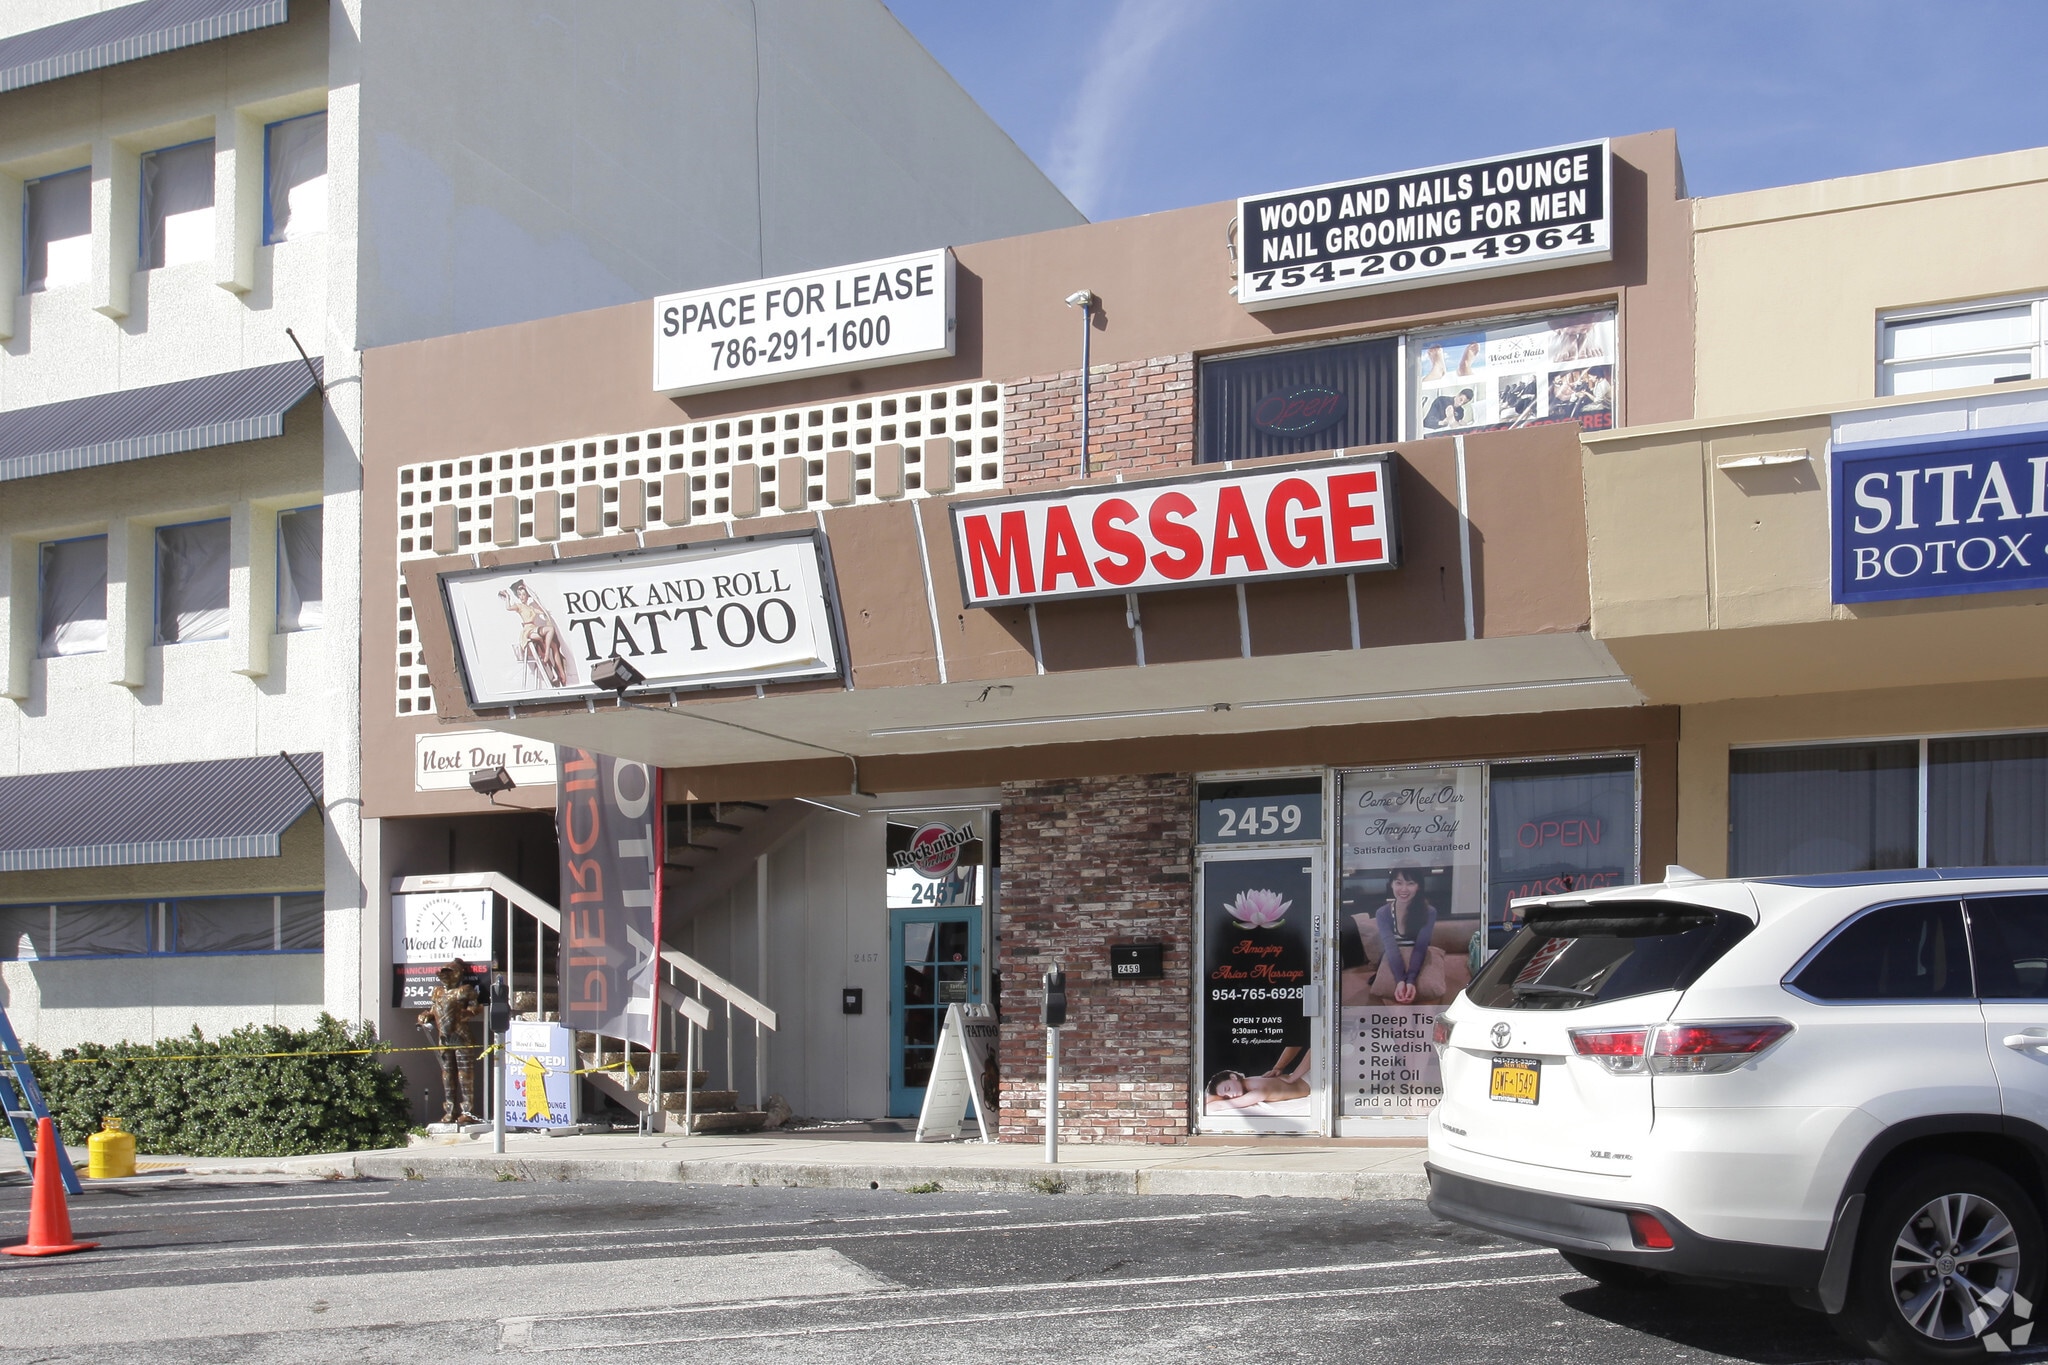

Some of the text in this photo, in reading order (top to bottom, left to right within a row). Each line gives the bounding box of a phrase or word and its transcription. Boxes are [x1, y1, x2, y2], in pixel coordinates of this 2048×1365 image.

[1259, 154, 1589, 232] WOOD AND NAILS LOUNGE
[1262, 188, 1587, 263] NAIL GROOMING FOR MEN
[1252, 223, 1595, 292] 754-200-4964
[663, 264, 934, 337] SPACE FOR LEASE
[711, 314, 890, 371] 786-291-1600
[1488, 352, 1513, 362] Wood
[1523, 349, 1545, 357] Nails
[963, 471, 1384, 598] MASSAGE
[1853, 533, 2032, 581] BOTOX
[563, 569, 792, 615] ROCK AND ROLL
[569, 598, 797, 661] TATTOO
[423, 744, 549, 771] Next Day Tax,
[1358, 785, 1465, 813] Come Meet Our
[1217, 804, 1302, 837] 2459
[1365, 815, 1461, 841] Amazing Staff
[1517, 819, 1600, 849] OPEN
[894, 841, 932, 867] Rock
[1353, 842, 1470, 855] Satisfaction Guaranteed
[911, 882, 960, 906] 2457
[401, 936, 482, 951] Wood & Nails
[1232, 940, 1284, 958] Amazing
[1118, 964, 1140, 973] 2459
[1211, 963, 1304, 984] Asian Massage
[1211, 987, 1304, 1001] 954-765-6928
[965, 1025, 998, 1037] TATTOO
[1371, 1014, 1408, 1027] Deep
[1371, 1028, 1425, 1039] Shiatsu
[1371, 1042, 1432, 1053] Swedish
[539, 1056, 566, 1067] PEDI
[1371, 1056, 1406, 1067] Reiki
[1370, 1070, 1420, 1081] Hot Oil
[1370, 1084, 1444, 1095] Hot Stone
[1354, 1096, 1379, 1107] and
[1384, 1099, 1392, 1107] a
[1396, 1096, 1412, 1107] lot
